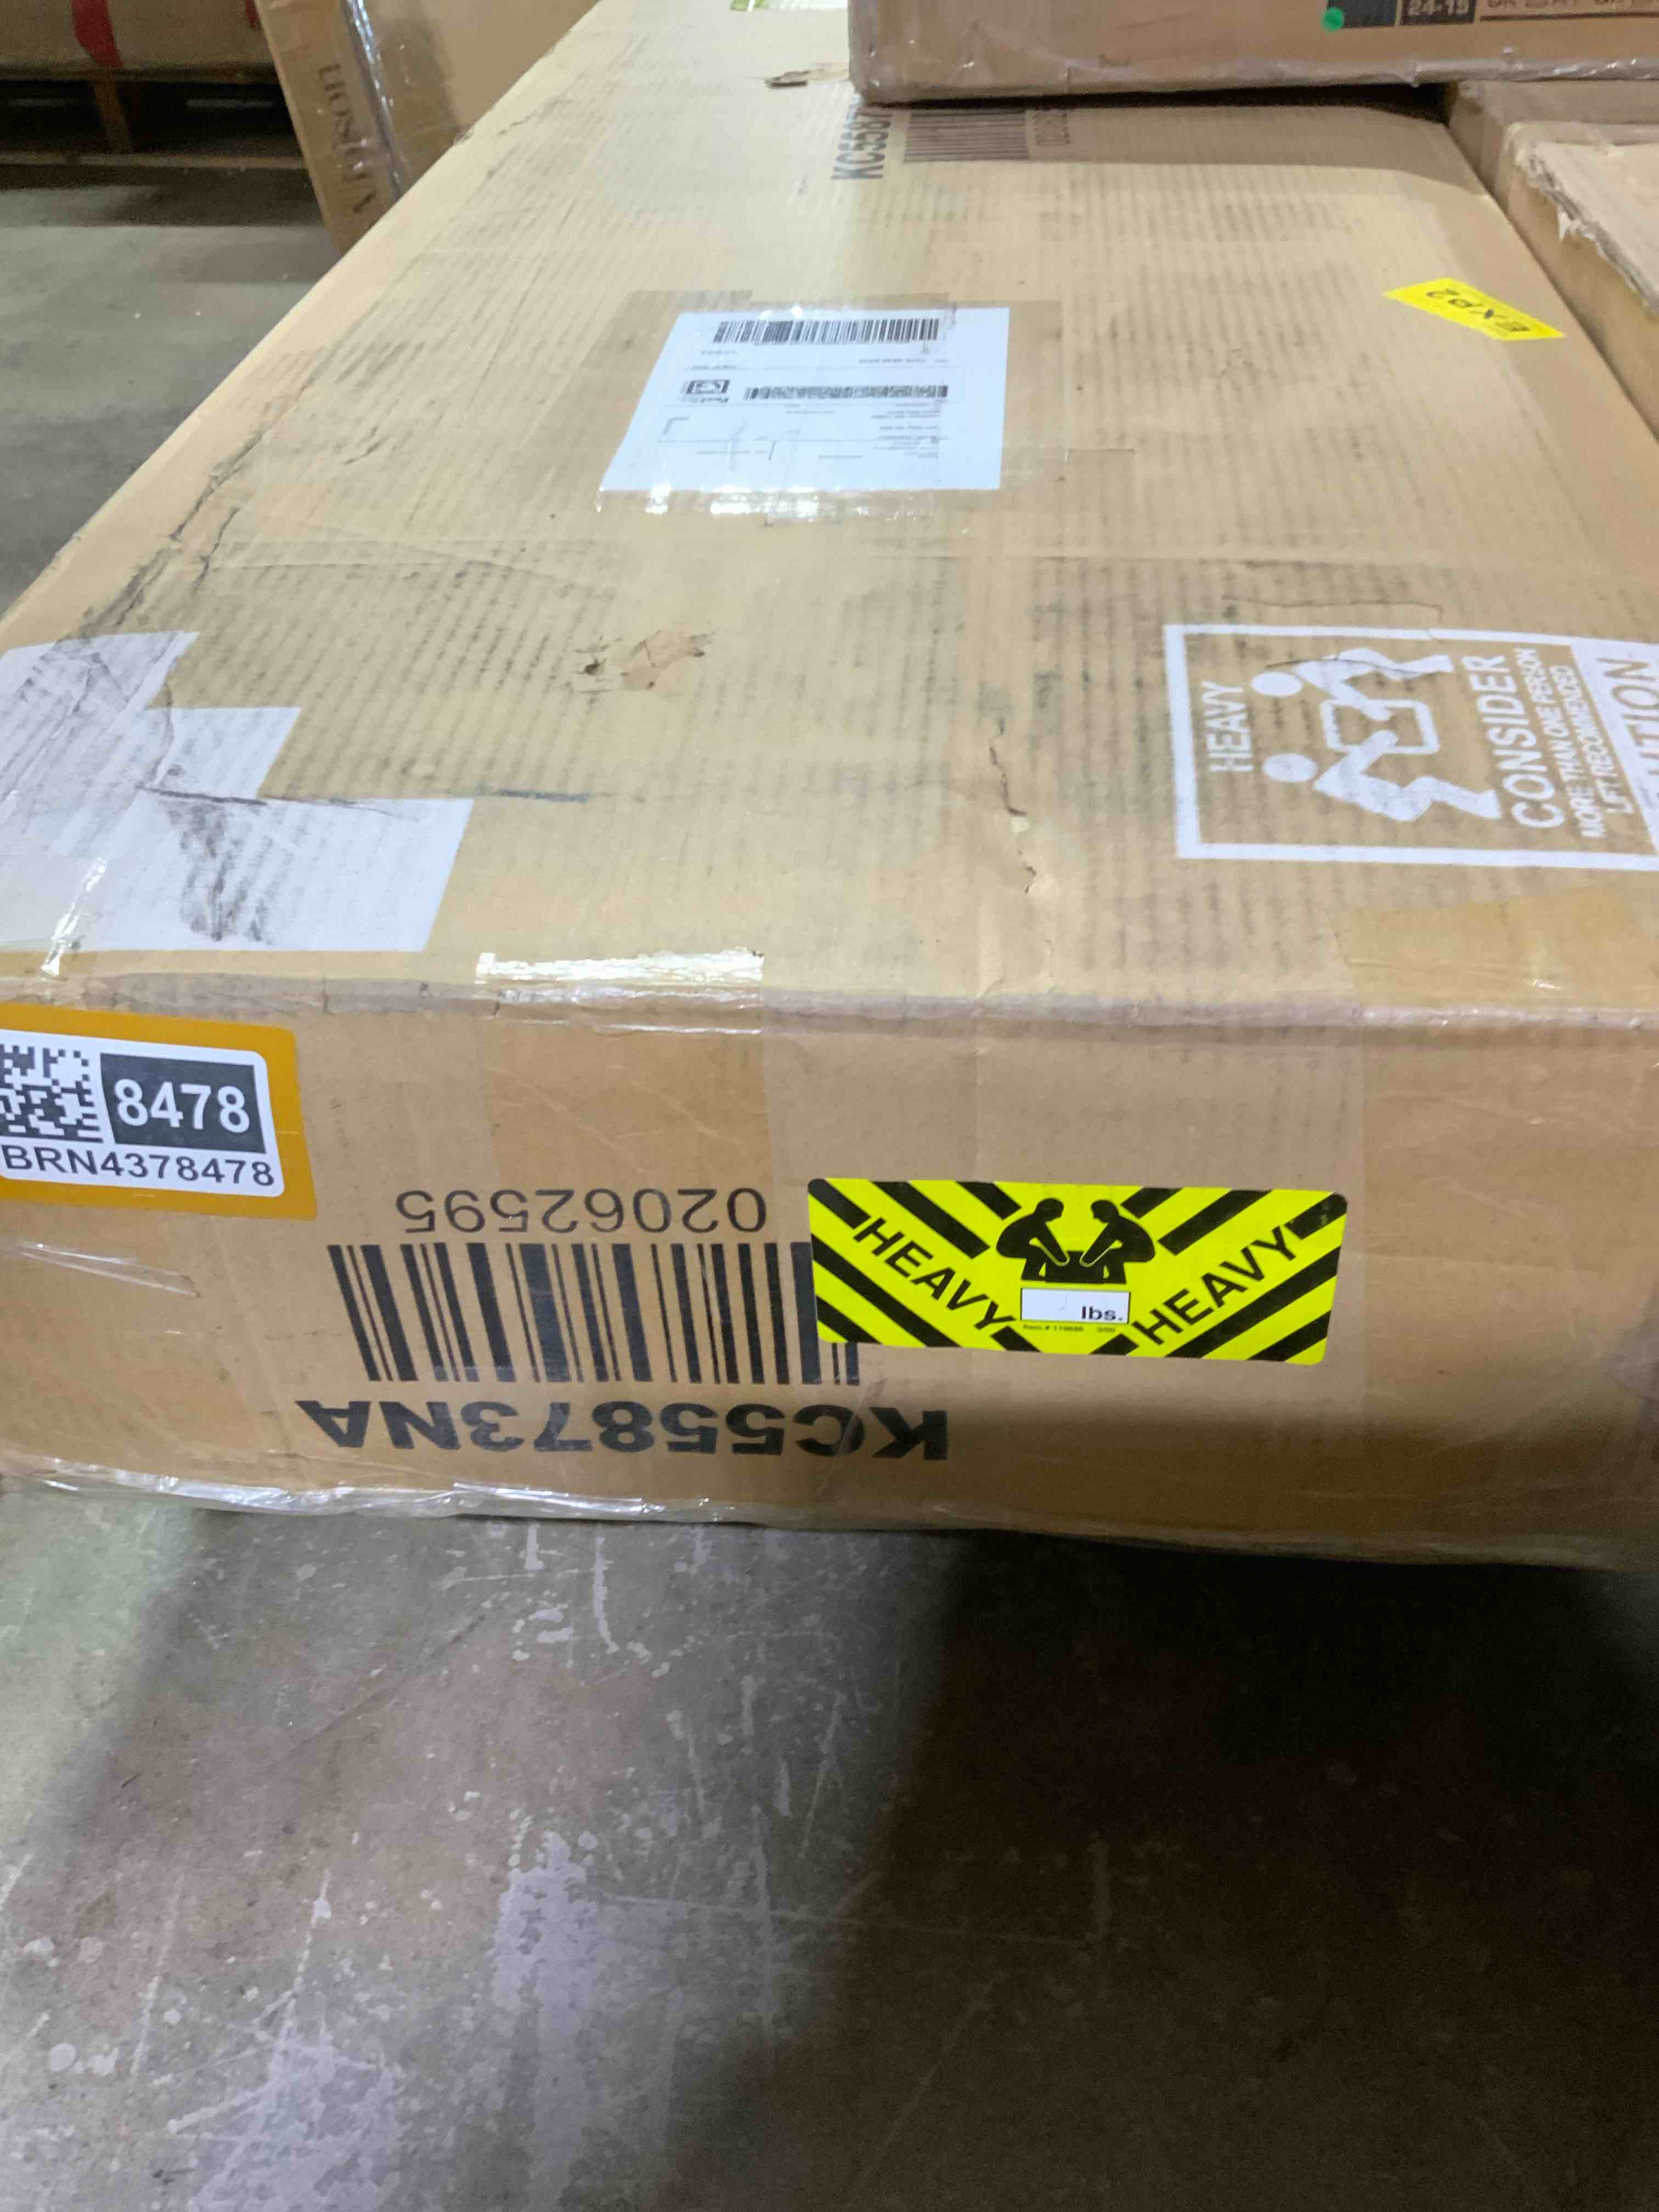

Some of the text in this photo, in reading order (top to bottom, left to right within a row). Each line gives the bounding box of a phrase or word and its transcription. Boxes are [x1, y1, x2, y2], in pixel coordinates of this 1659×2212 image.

[1201, 680, 1254, 773] HEAVY
[1462, 654, 1566, 829] CONSIDER
[1513, 648, 1607, 838] MORE THAN ONE PERSON
[1549, 665, 1634, 815] LIFT RECOMMENDED
[112, 1077, 251, 1134] 8478
[1, 1143, 275, 1187] BRN4378478
[394, 1187, 768, 1234] 02062595
[853, 1216, 1015, 1333] HEAVY
[1081, 1305, 1124, 1321] lbs.
[1130, 1224, 1299, 1347] HEAVY
[295, 1397, 950, 1461] KC55873NA
